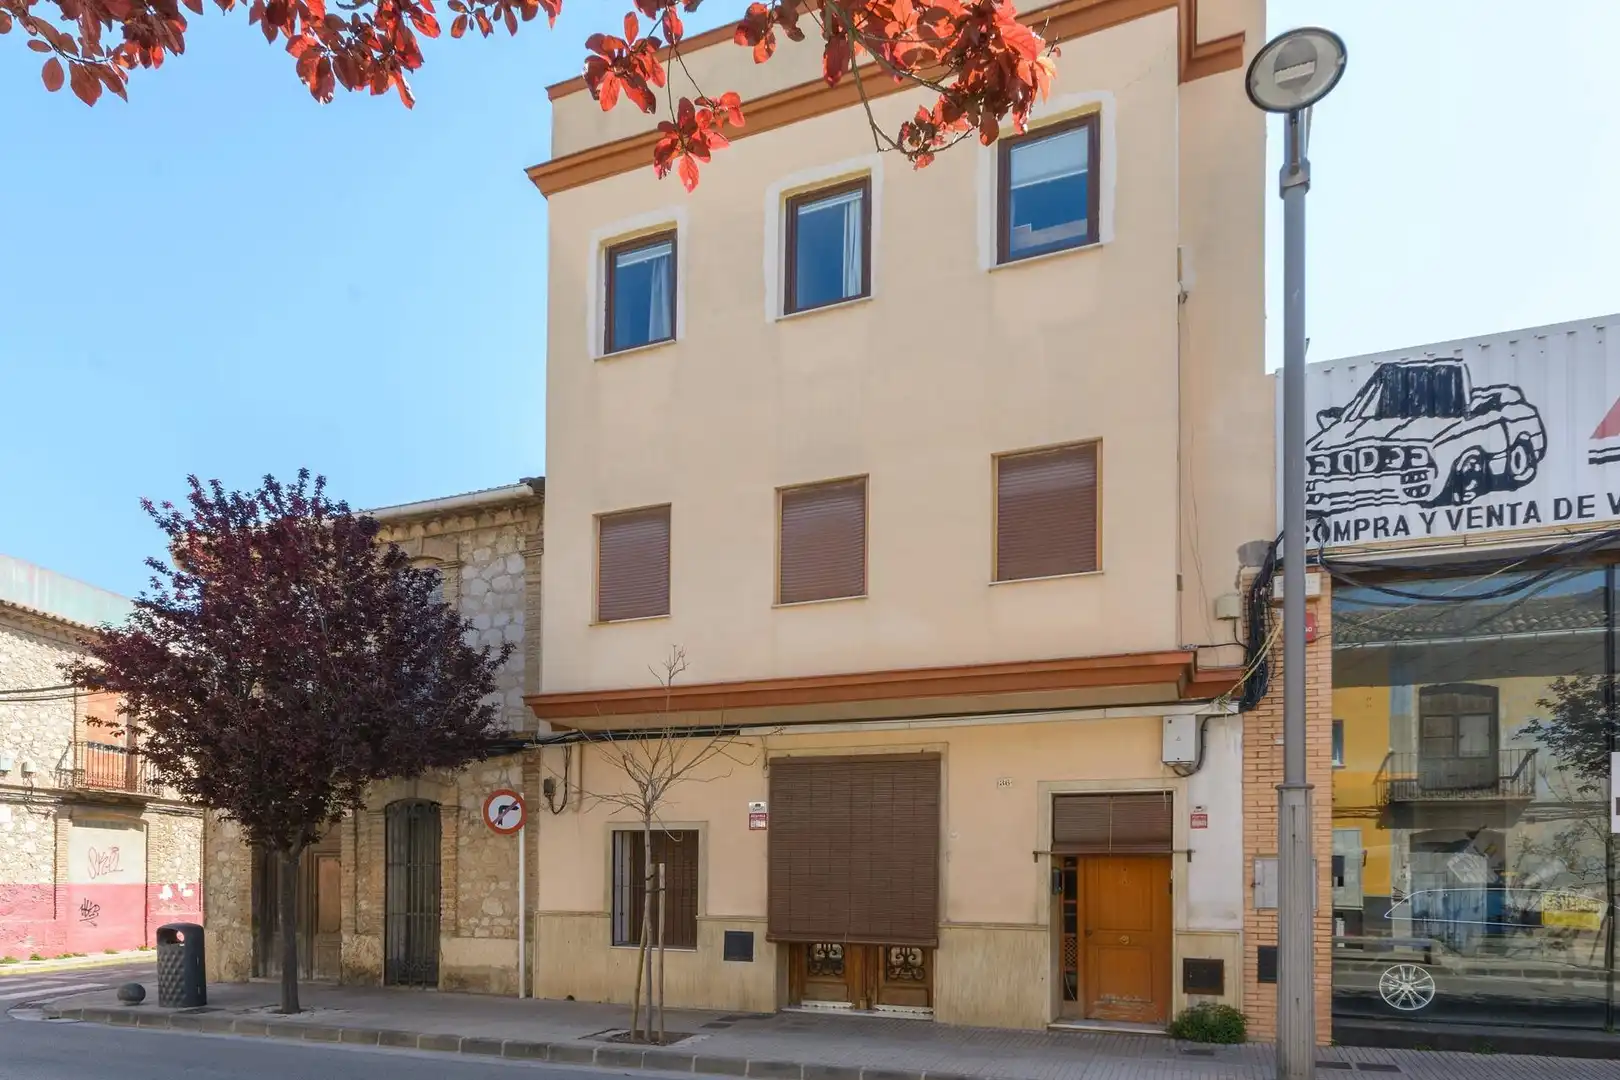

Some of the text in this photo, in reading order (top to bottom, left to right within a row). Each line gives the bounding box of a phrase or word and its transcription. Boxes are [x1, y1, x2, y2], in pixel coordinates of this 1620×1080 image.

[1419, 511, 1437, 534] Y
[1446, 501, 1542, 531] VENTA
[1554, 494, 1596, 521] DE
